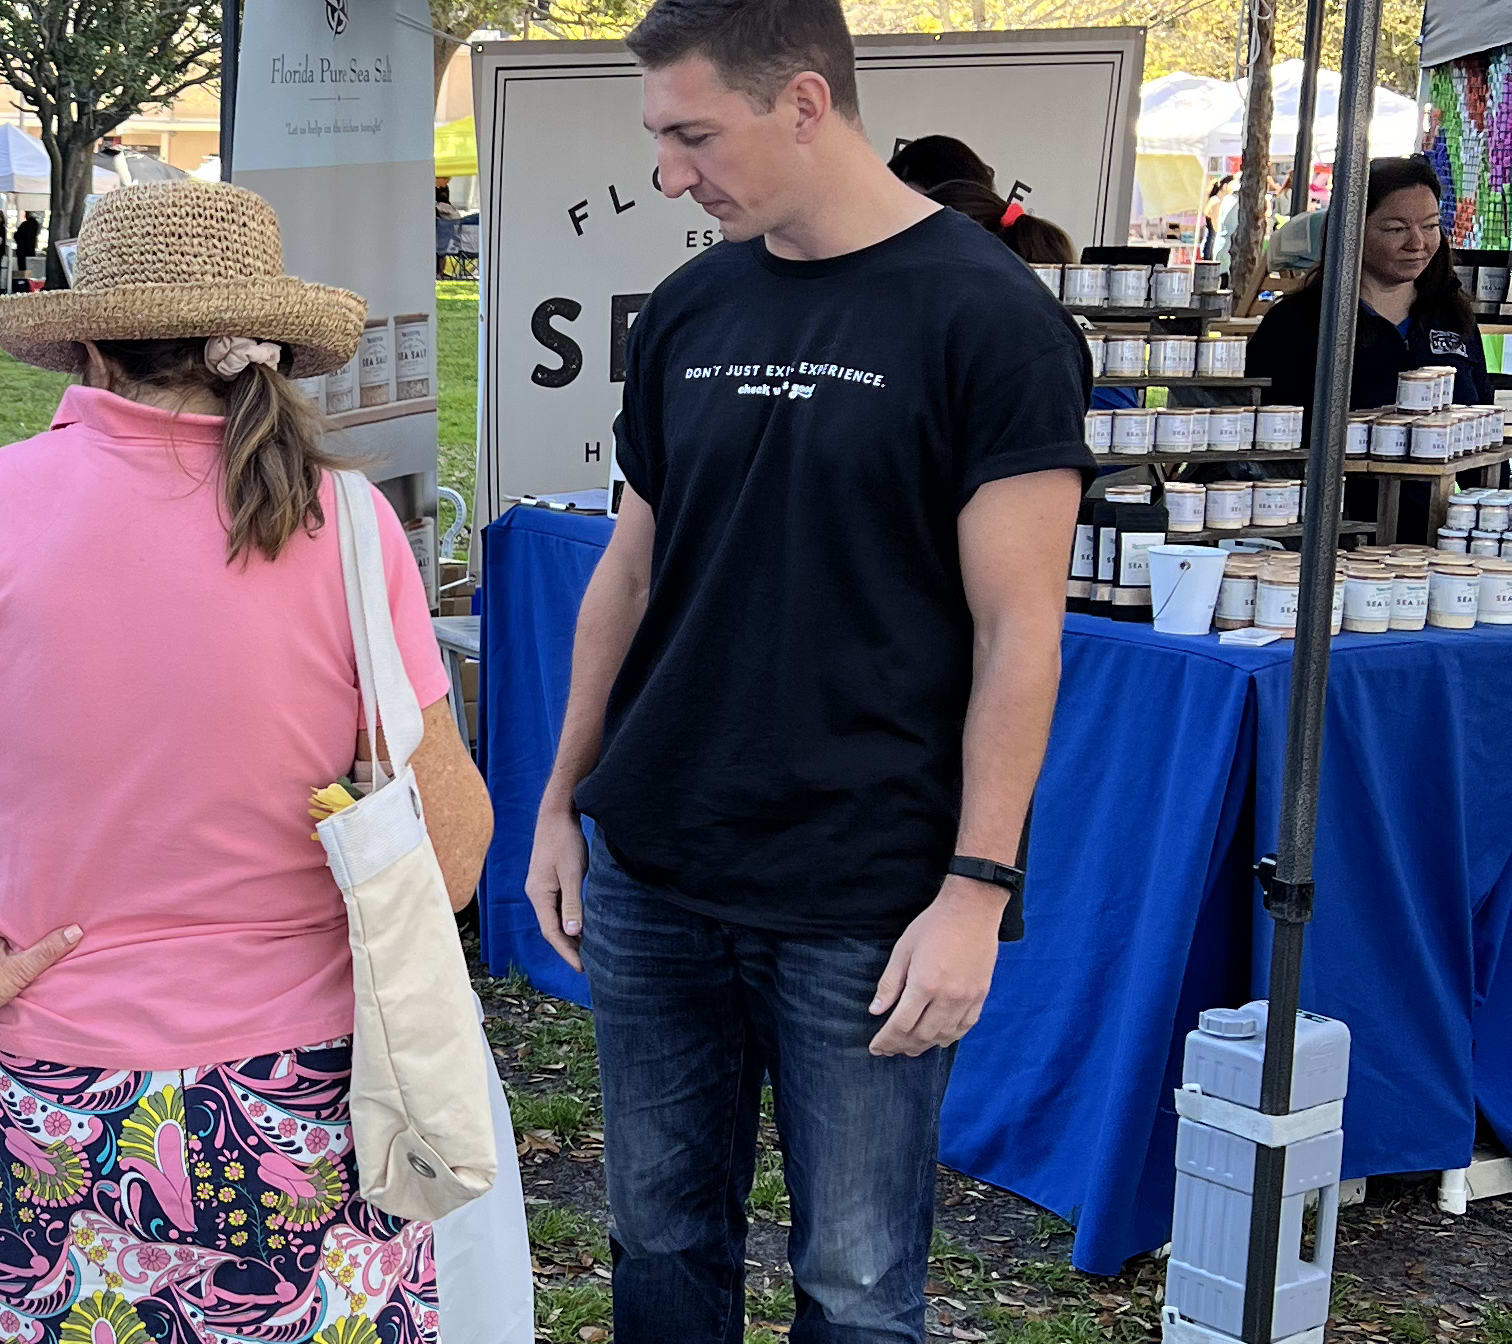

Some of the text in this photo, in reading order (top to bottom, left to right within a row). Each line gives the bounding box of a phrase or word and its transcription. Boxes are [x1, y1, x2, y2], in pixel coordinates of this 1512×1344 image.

[271, 53, 314, 84] Florida
[320, 57, 347, 84] Pure
[349, 58, 370, 84] Sea
[685, 365, 722, 379] DON'T
[726, 364, 761, 377] JUST
[737, 383, 771, 396] check
